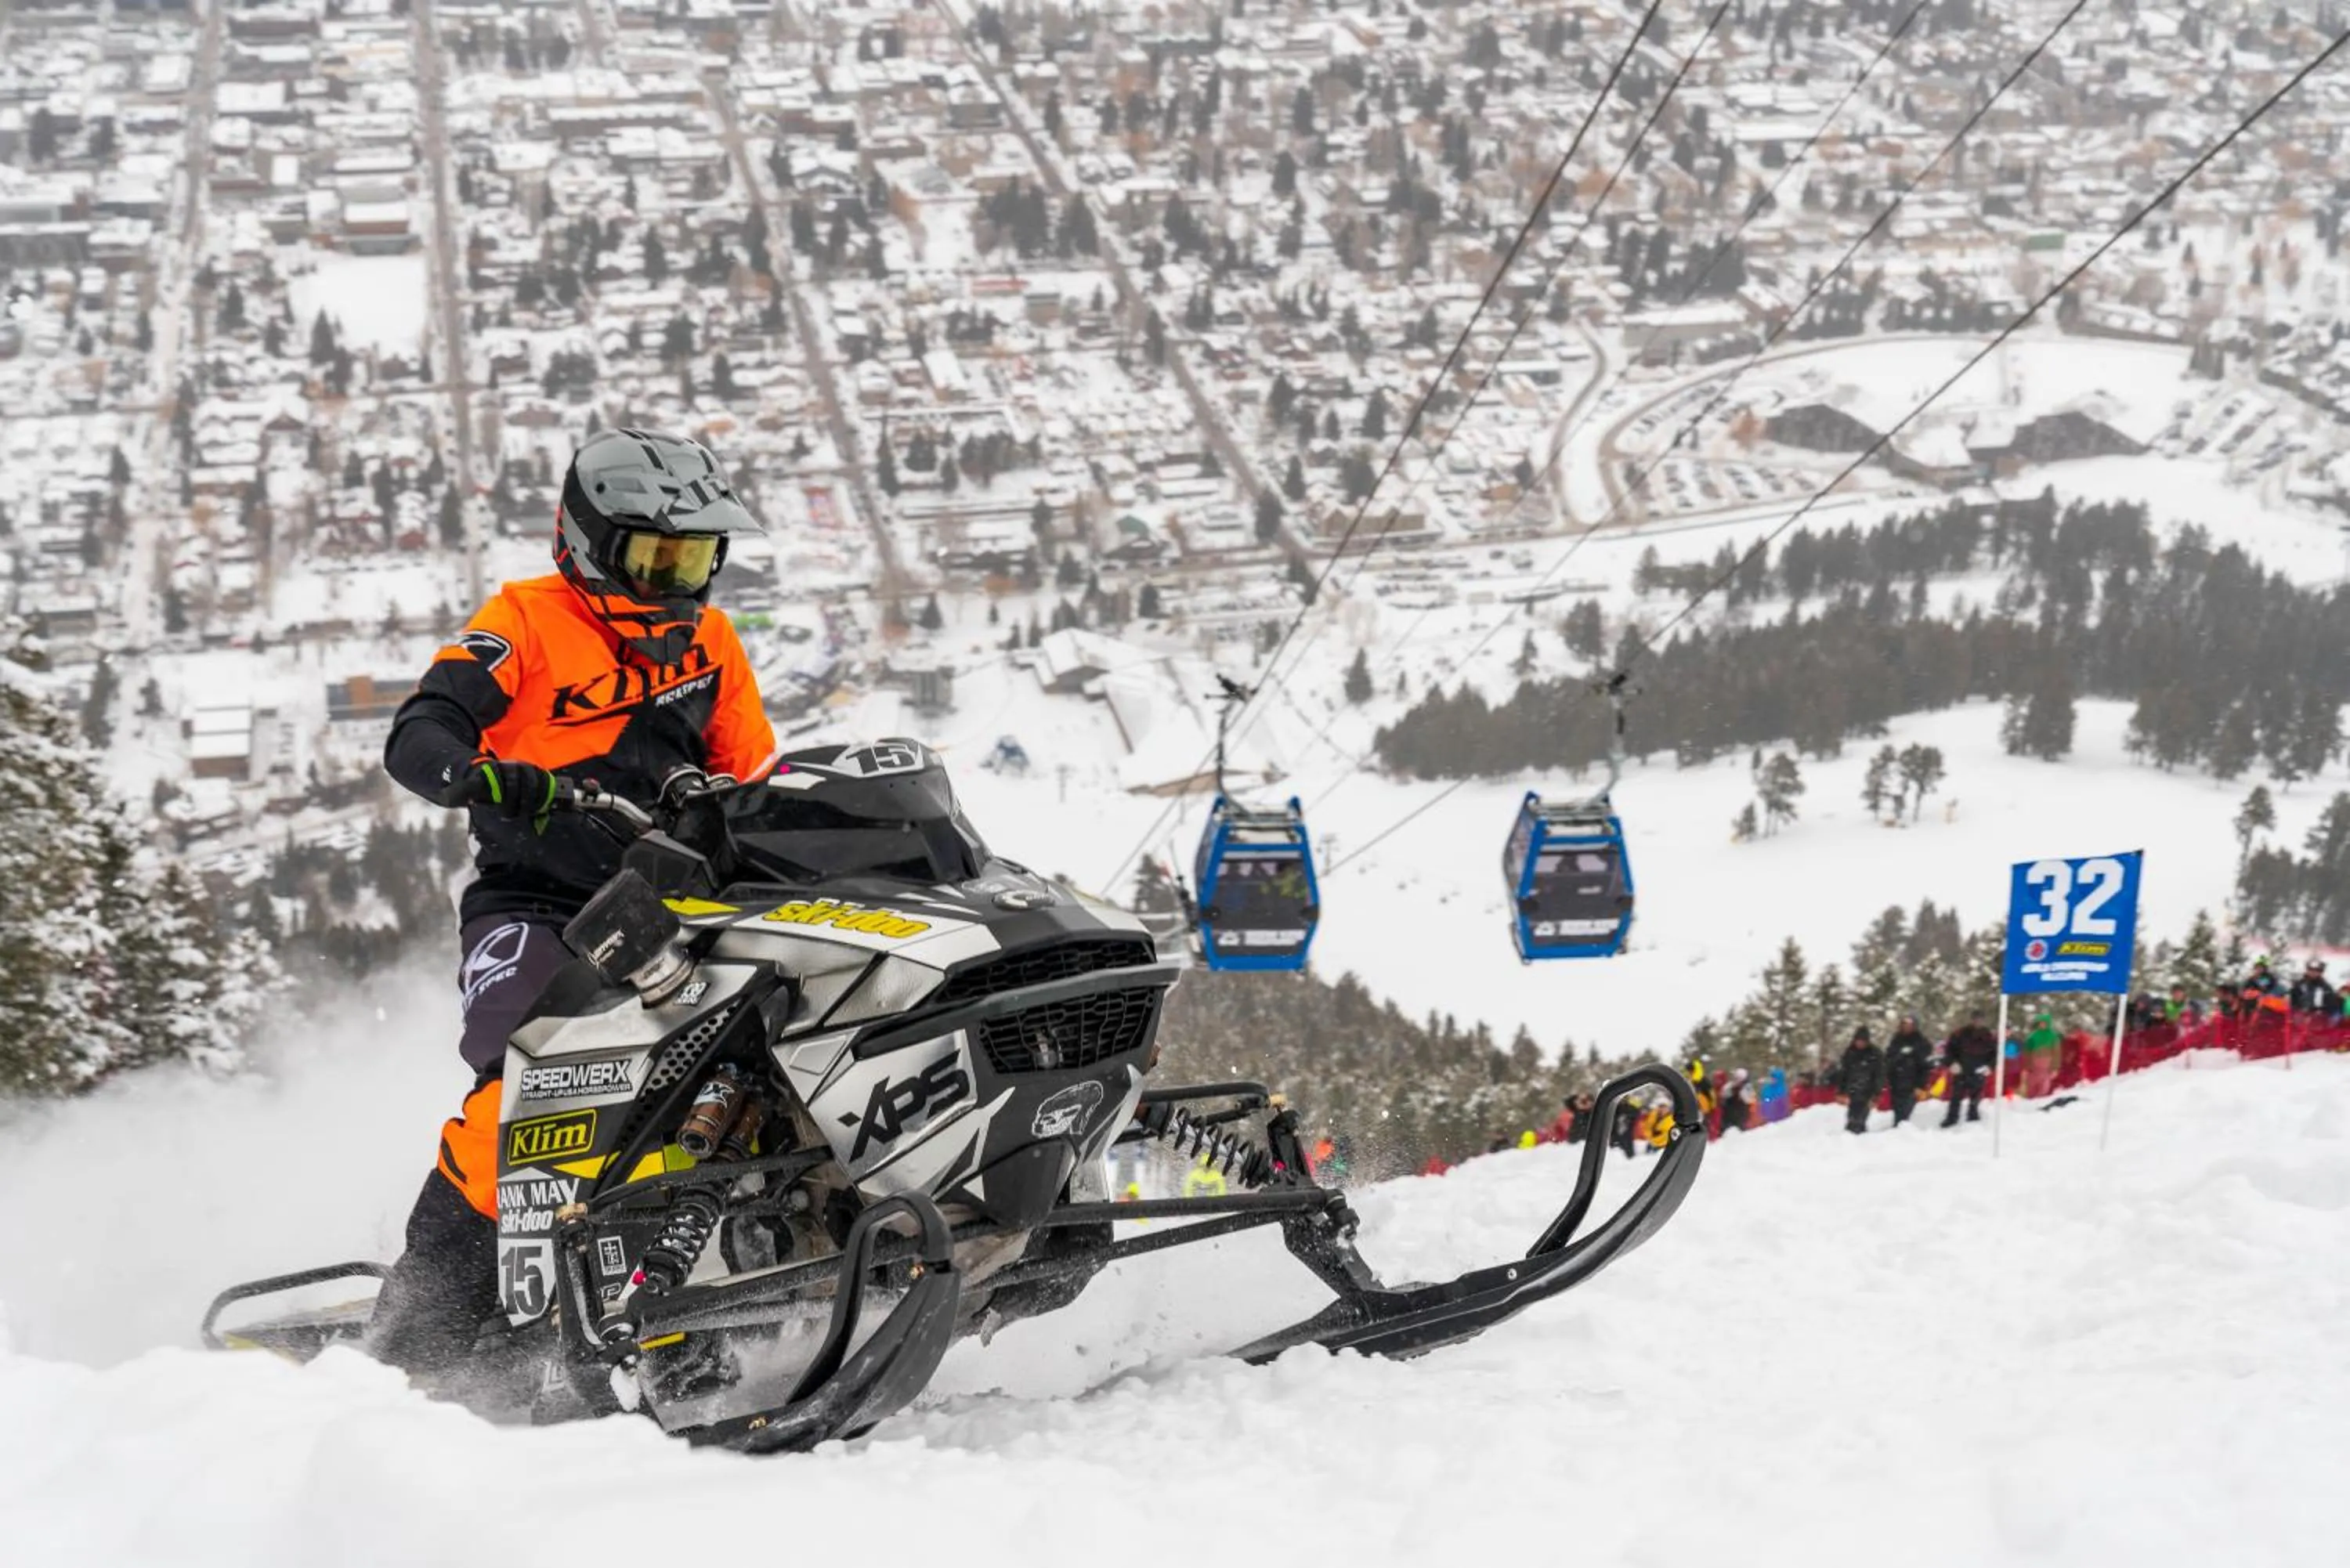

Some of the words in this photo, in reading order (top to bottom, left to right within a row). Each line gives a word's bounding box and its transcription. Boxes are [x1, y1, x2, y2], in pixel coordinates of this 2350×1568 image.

[845, 744, 916, 775] 15
[2021, 858, 2125, 938] 32
[521, 1060, 629, 1091] SPEEDWERX
[837, 1048, 971, 1165] XPS
[530, 1177, 580, 1207] MAY
[501, 1206, 554, 1235] ski-doo
[501, 1246, 548, 1317] 15
